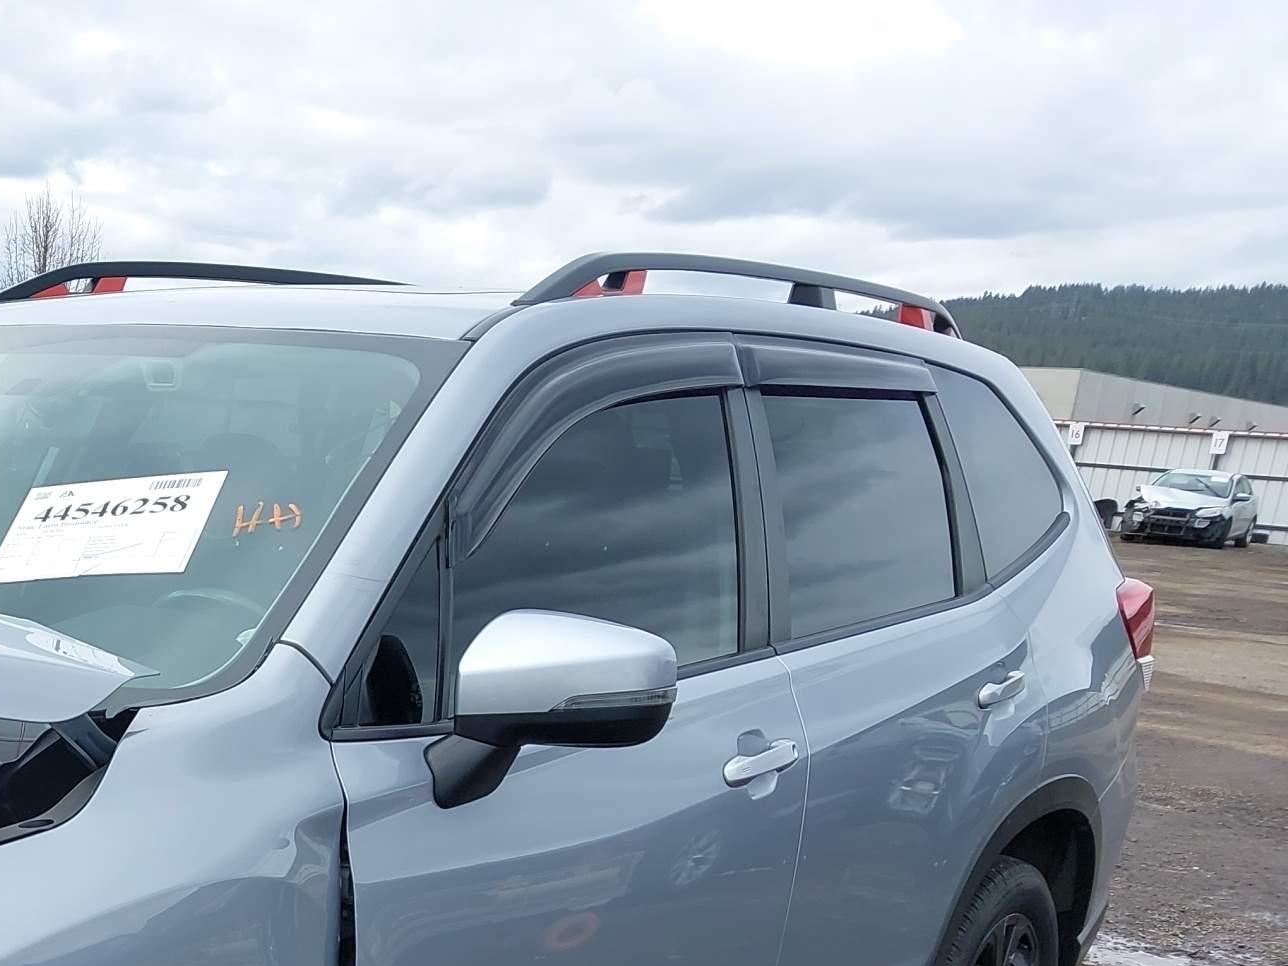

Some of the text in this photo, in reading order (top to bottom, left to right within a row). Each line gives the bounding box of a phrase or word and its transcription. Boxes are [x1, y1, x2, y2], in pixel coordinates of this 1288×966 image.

[1071, 429, 1081, 439] 16
[1214, 438, 1225, 448] 17
[34, 496, 191, 522] 44546258
